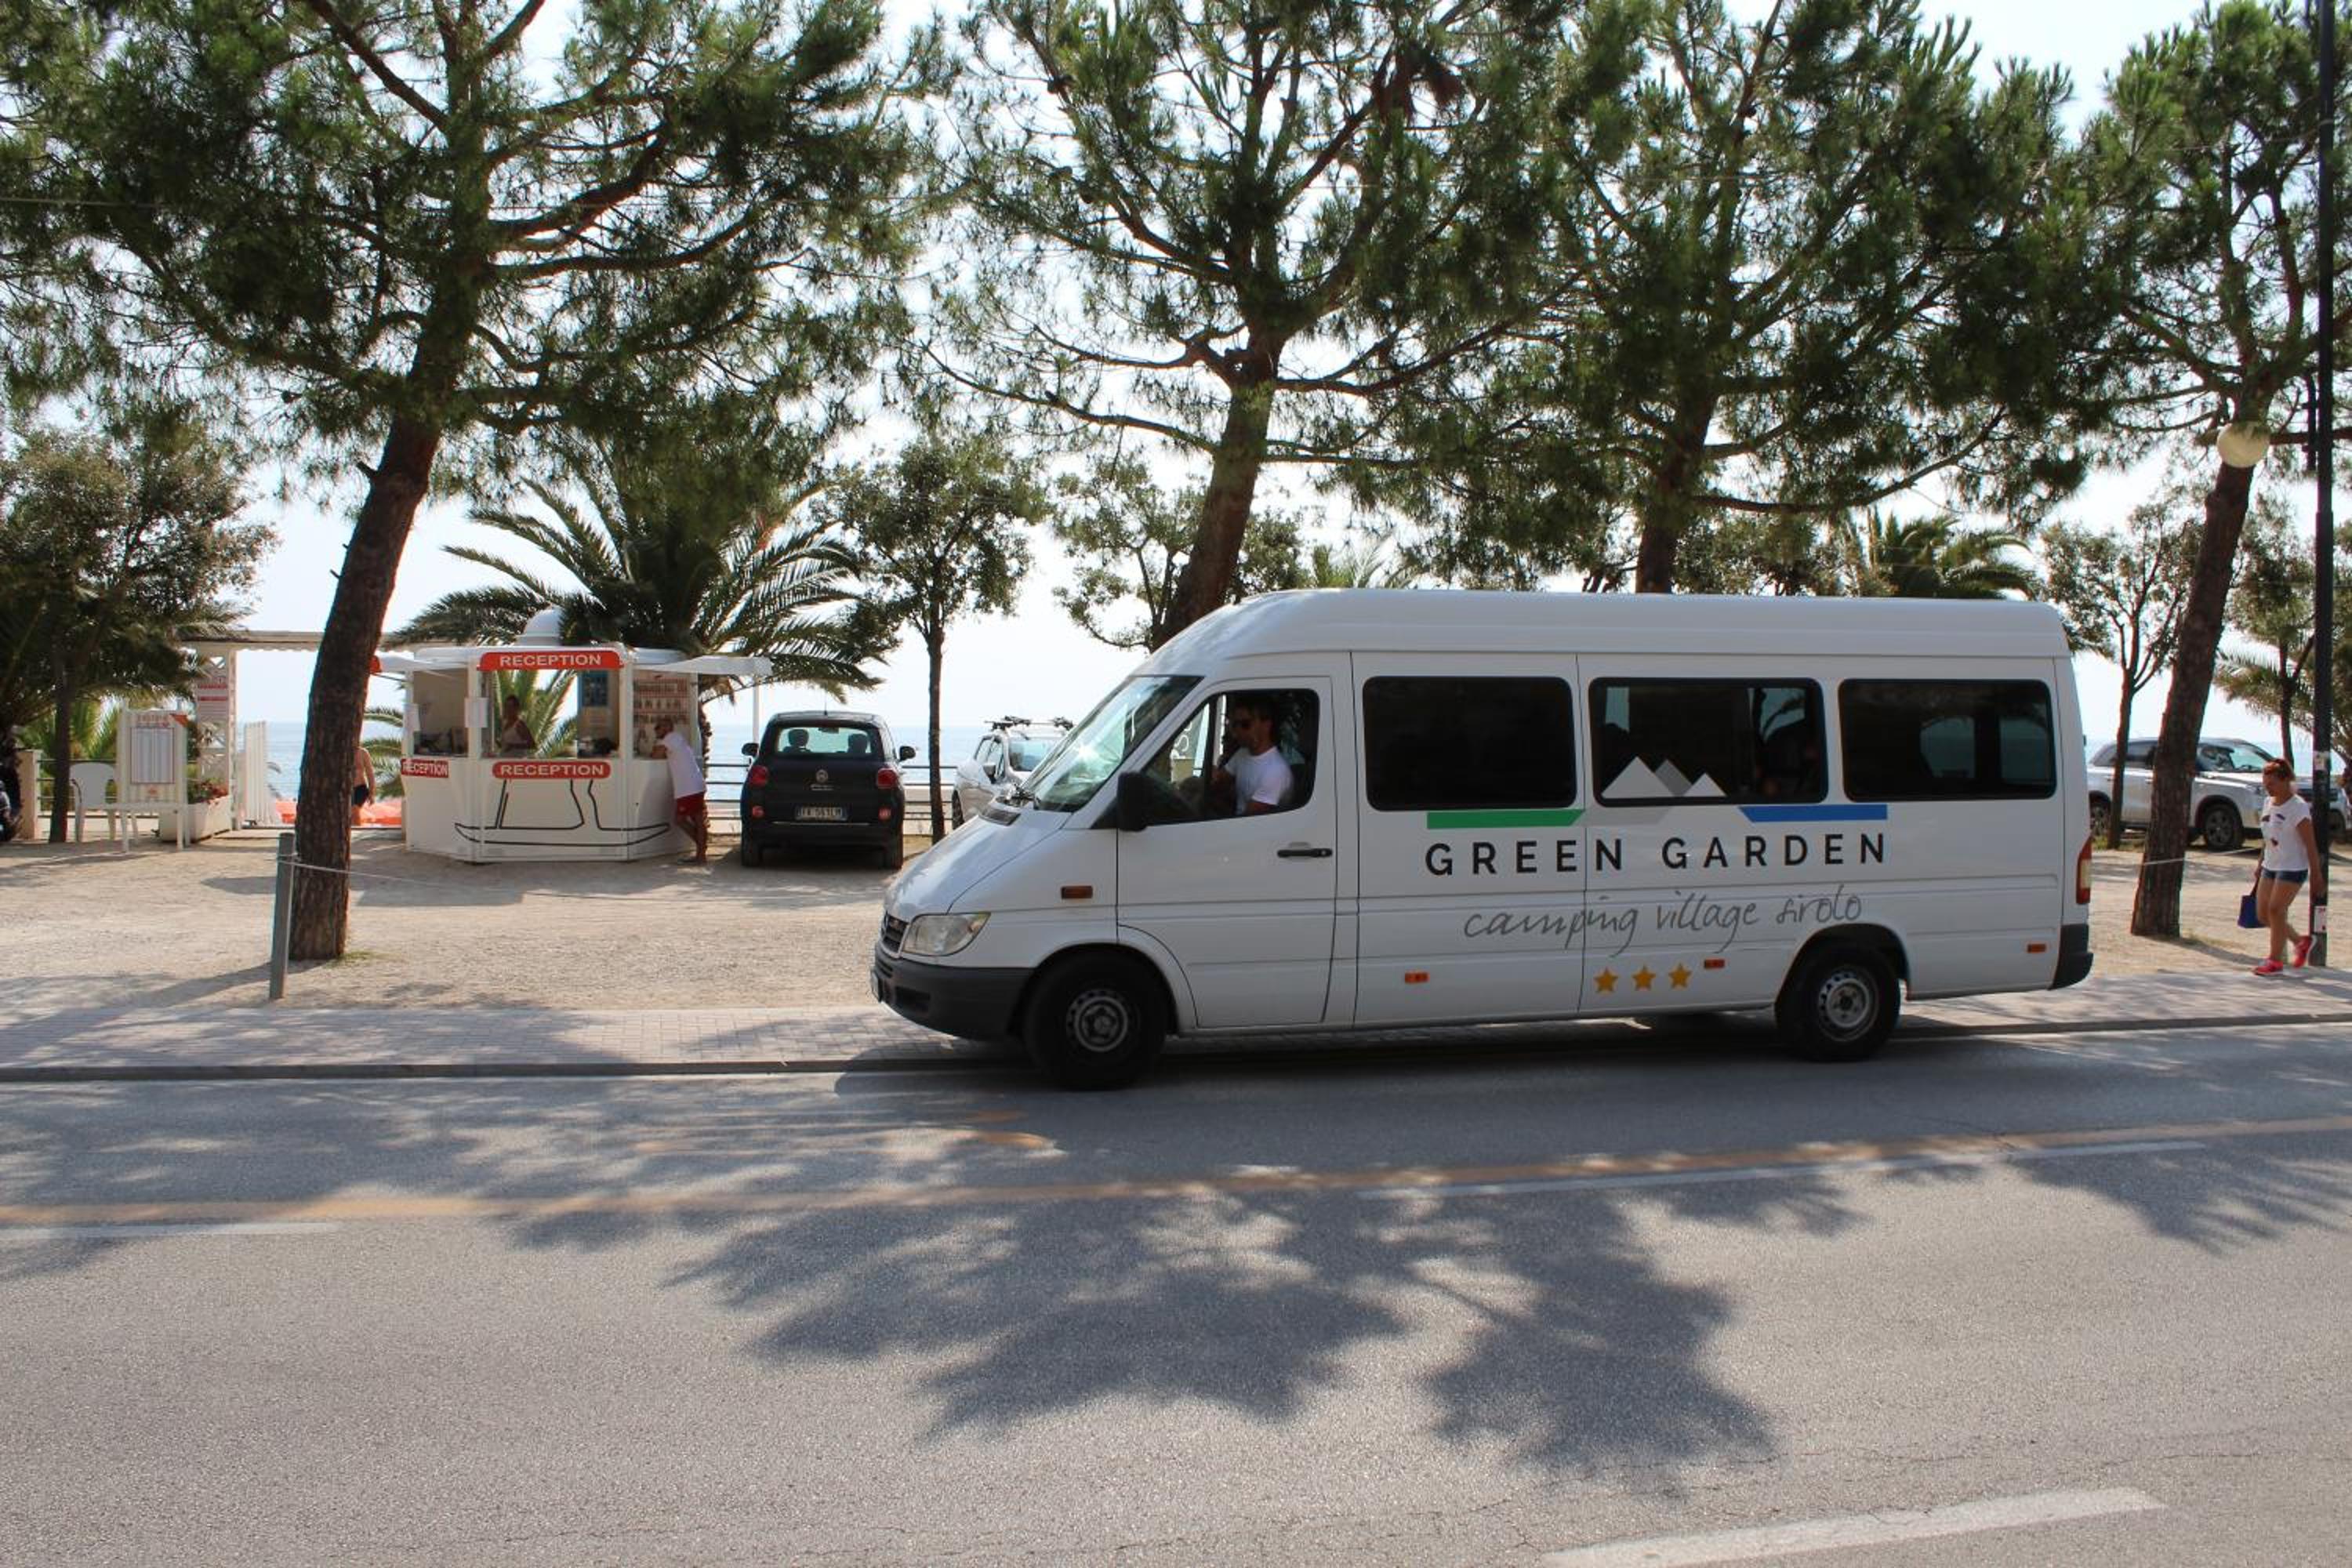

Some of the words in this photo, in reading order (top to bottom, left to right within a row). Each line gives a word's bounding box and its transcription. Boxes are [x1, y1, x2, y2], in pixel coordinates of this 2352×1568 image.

[499, 654, 602, 666] RECEPTION
[500, 764, 604, 776] RECEPTION
[1425, 838, 1623, 877] GREEN
[1661, 833, 1885, 869] GARDEN
[1464, 895, 1639, 959] camping
[1656, 890, 1761, 954] village
[1776, 884, 1863, 925] sirolo
